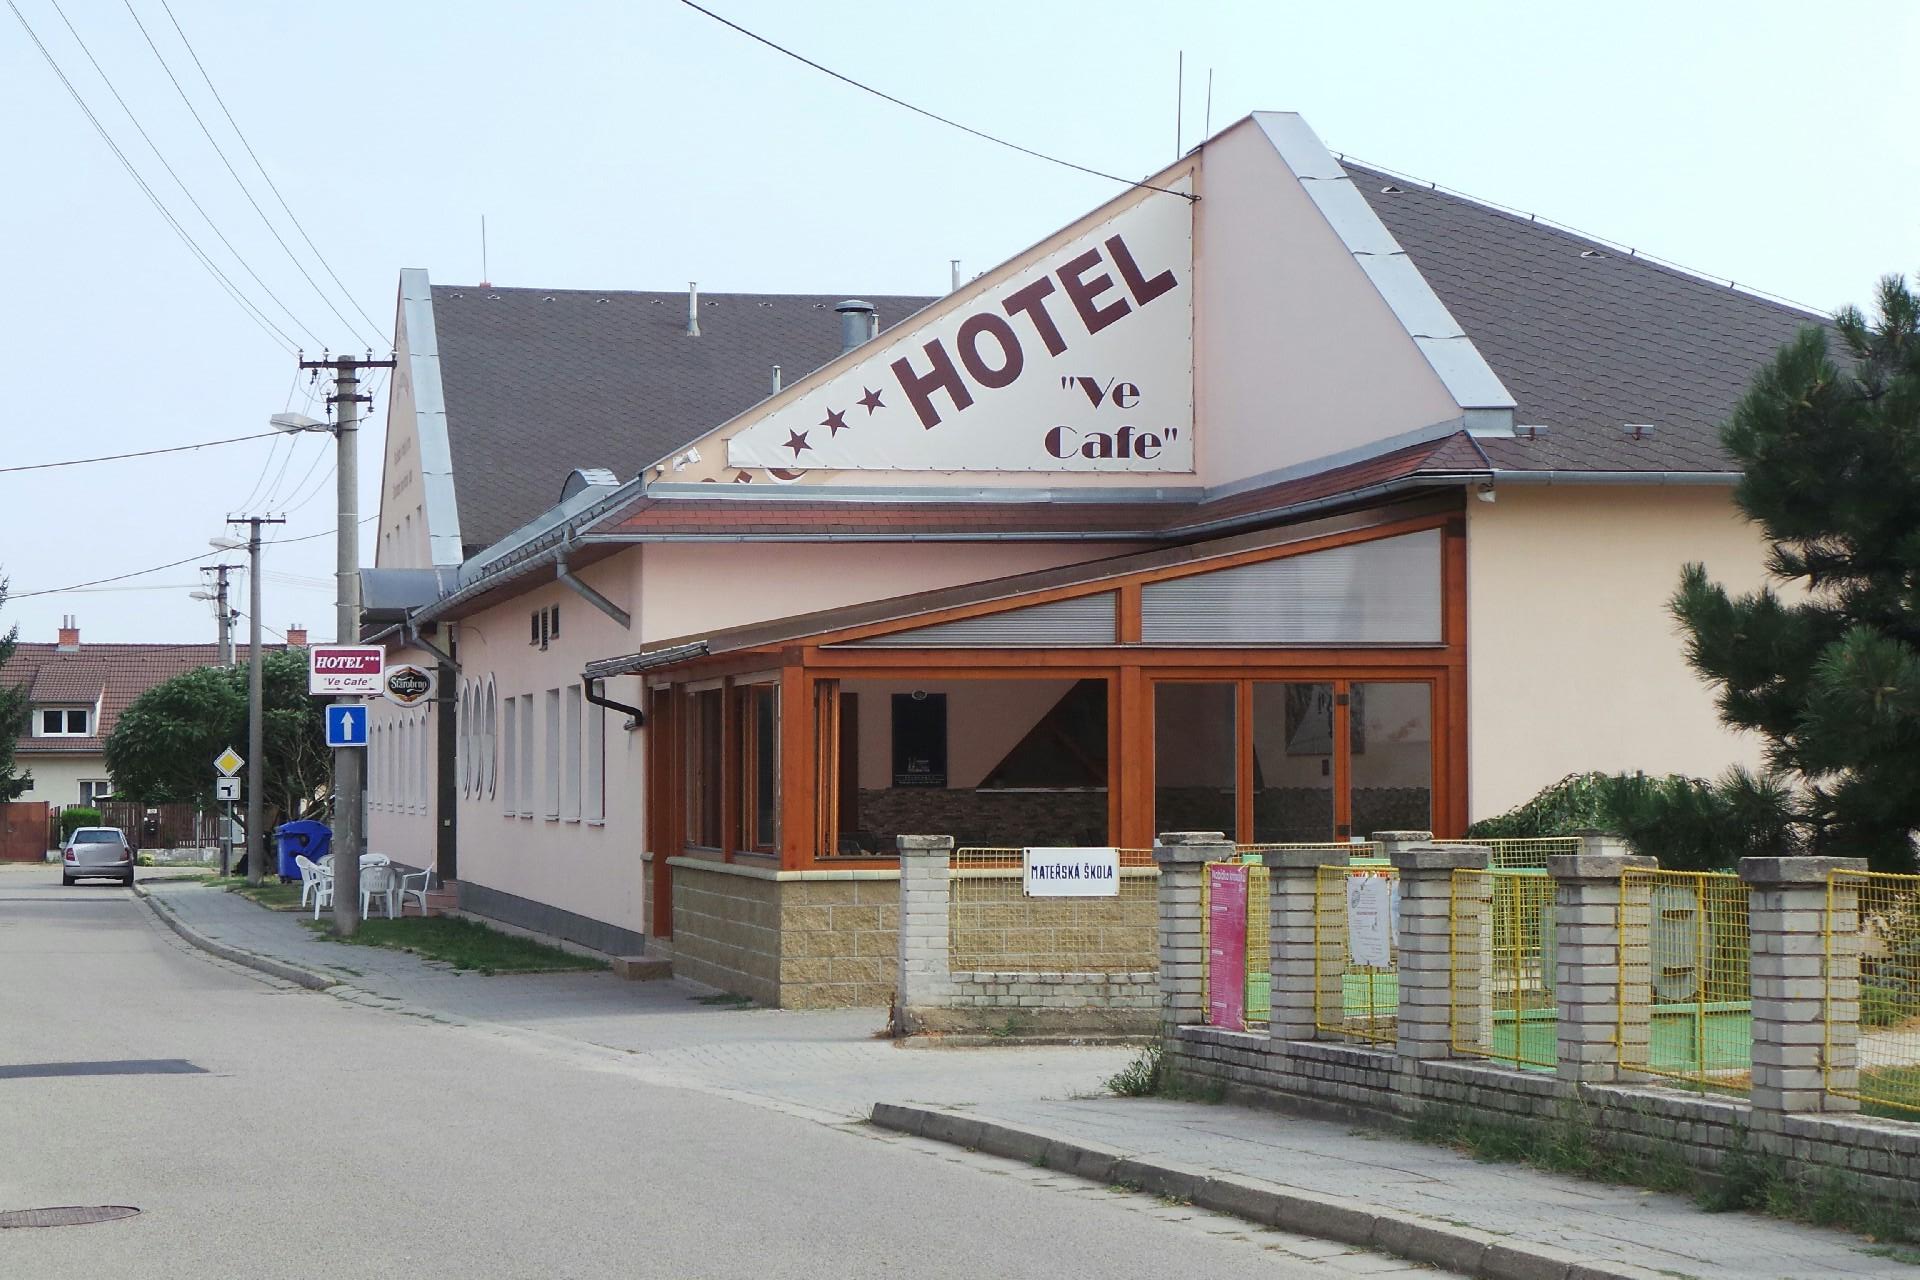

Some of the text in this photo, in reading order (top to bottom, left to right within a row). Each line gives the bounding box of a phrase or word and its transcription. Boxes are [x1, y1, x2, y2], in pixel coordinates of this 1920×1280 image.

[891, 234, 1178, 430] HOTEL
[1061, 376, 1140, 409] "Ve
[1044, 425, 1178, 460] Cafe"
[316, 656, 365, 669] HOTEL
[390, 676, 427, 693] Starobrno
[1031, 862, 1113, 880] MATEŘSKÁ ŠKOLA
